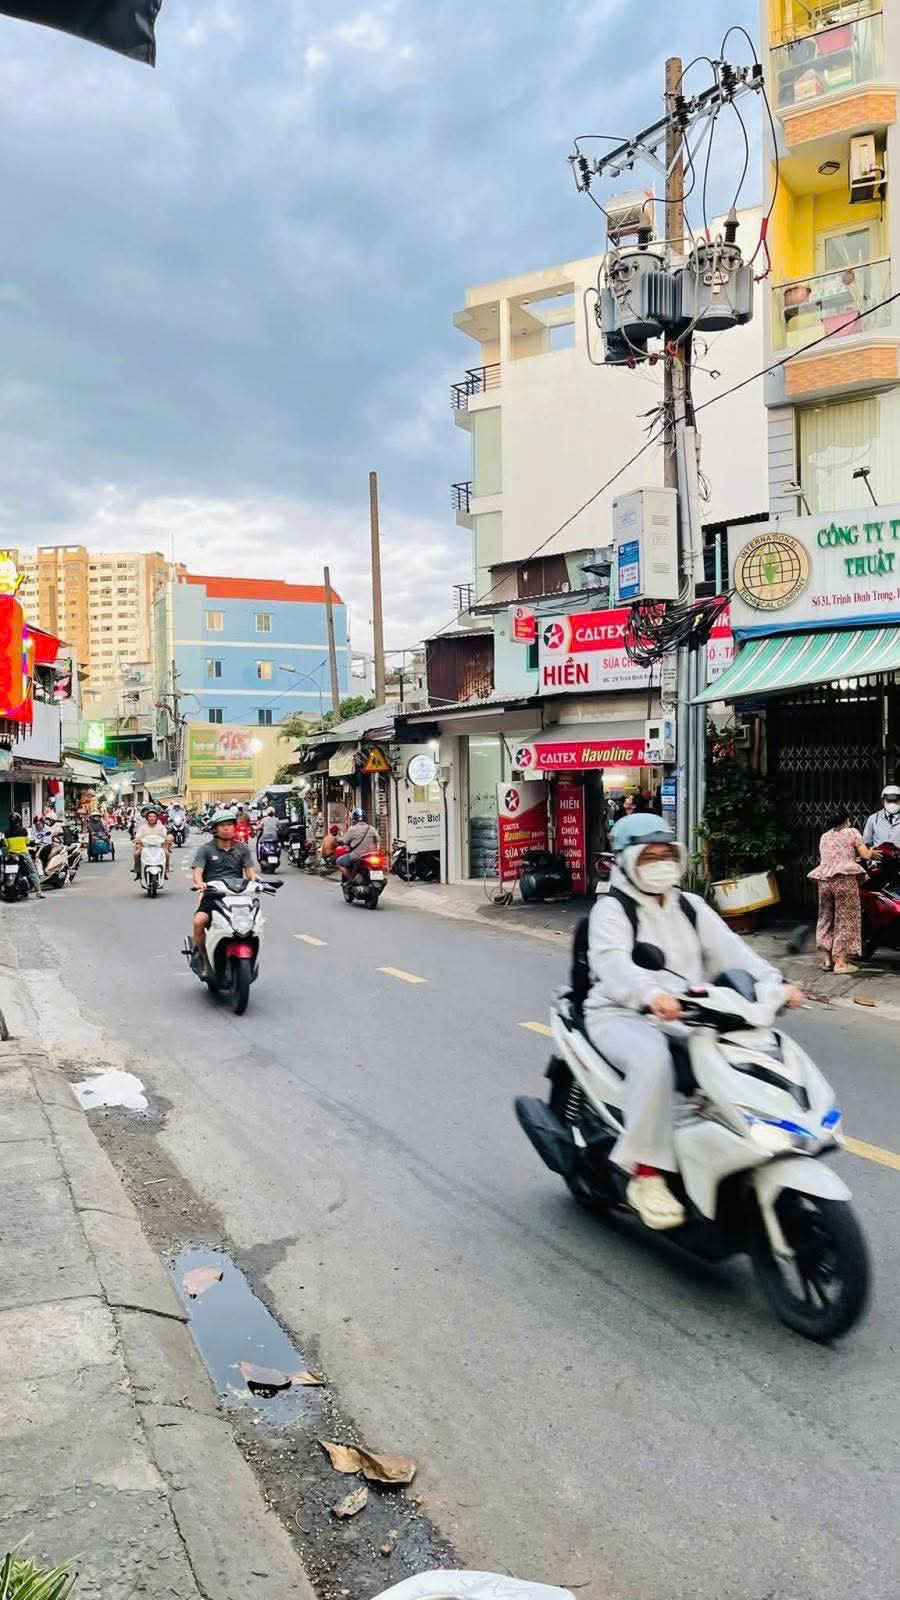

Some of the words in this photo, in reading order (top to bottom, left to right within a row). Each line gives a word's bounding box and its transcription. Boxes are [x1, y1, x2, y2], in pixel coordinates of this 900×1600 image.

[741, 535, 798, 559] INTERNATIONAL
[817, 522, 860, 549] CÔNG
[863, 521, 885, 544] TY
[844, 548, 896, 578] THUẬT
[740, 586, 774, 607] TECHNICAL
[777, 577, 806, 607] COMPANY
[575, 625, 625, 642] CALTEX
[543, 656, 589, 686] HIỀN
[540, 752, 576, 764] CALTEX
[581, 746, 634, 762] Havoline
